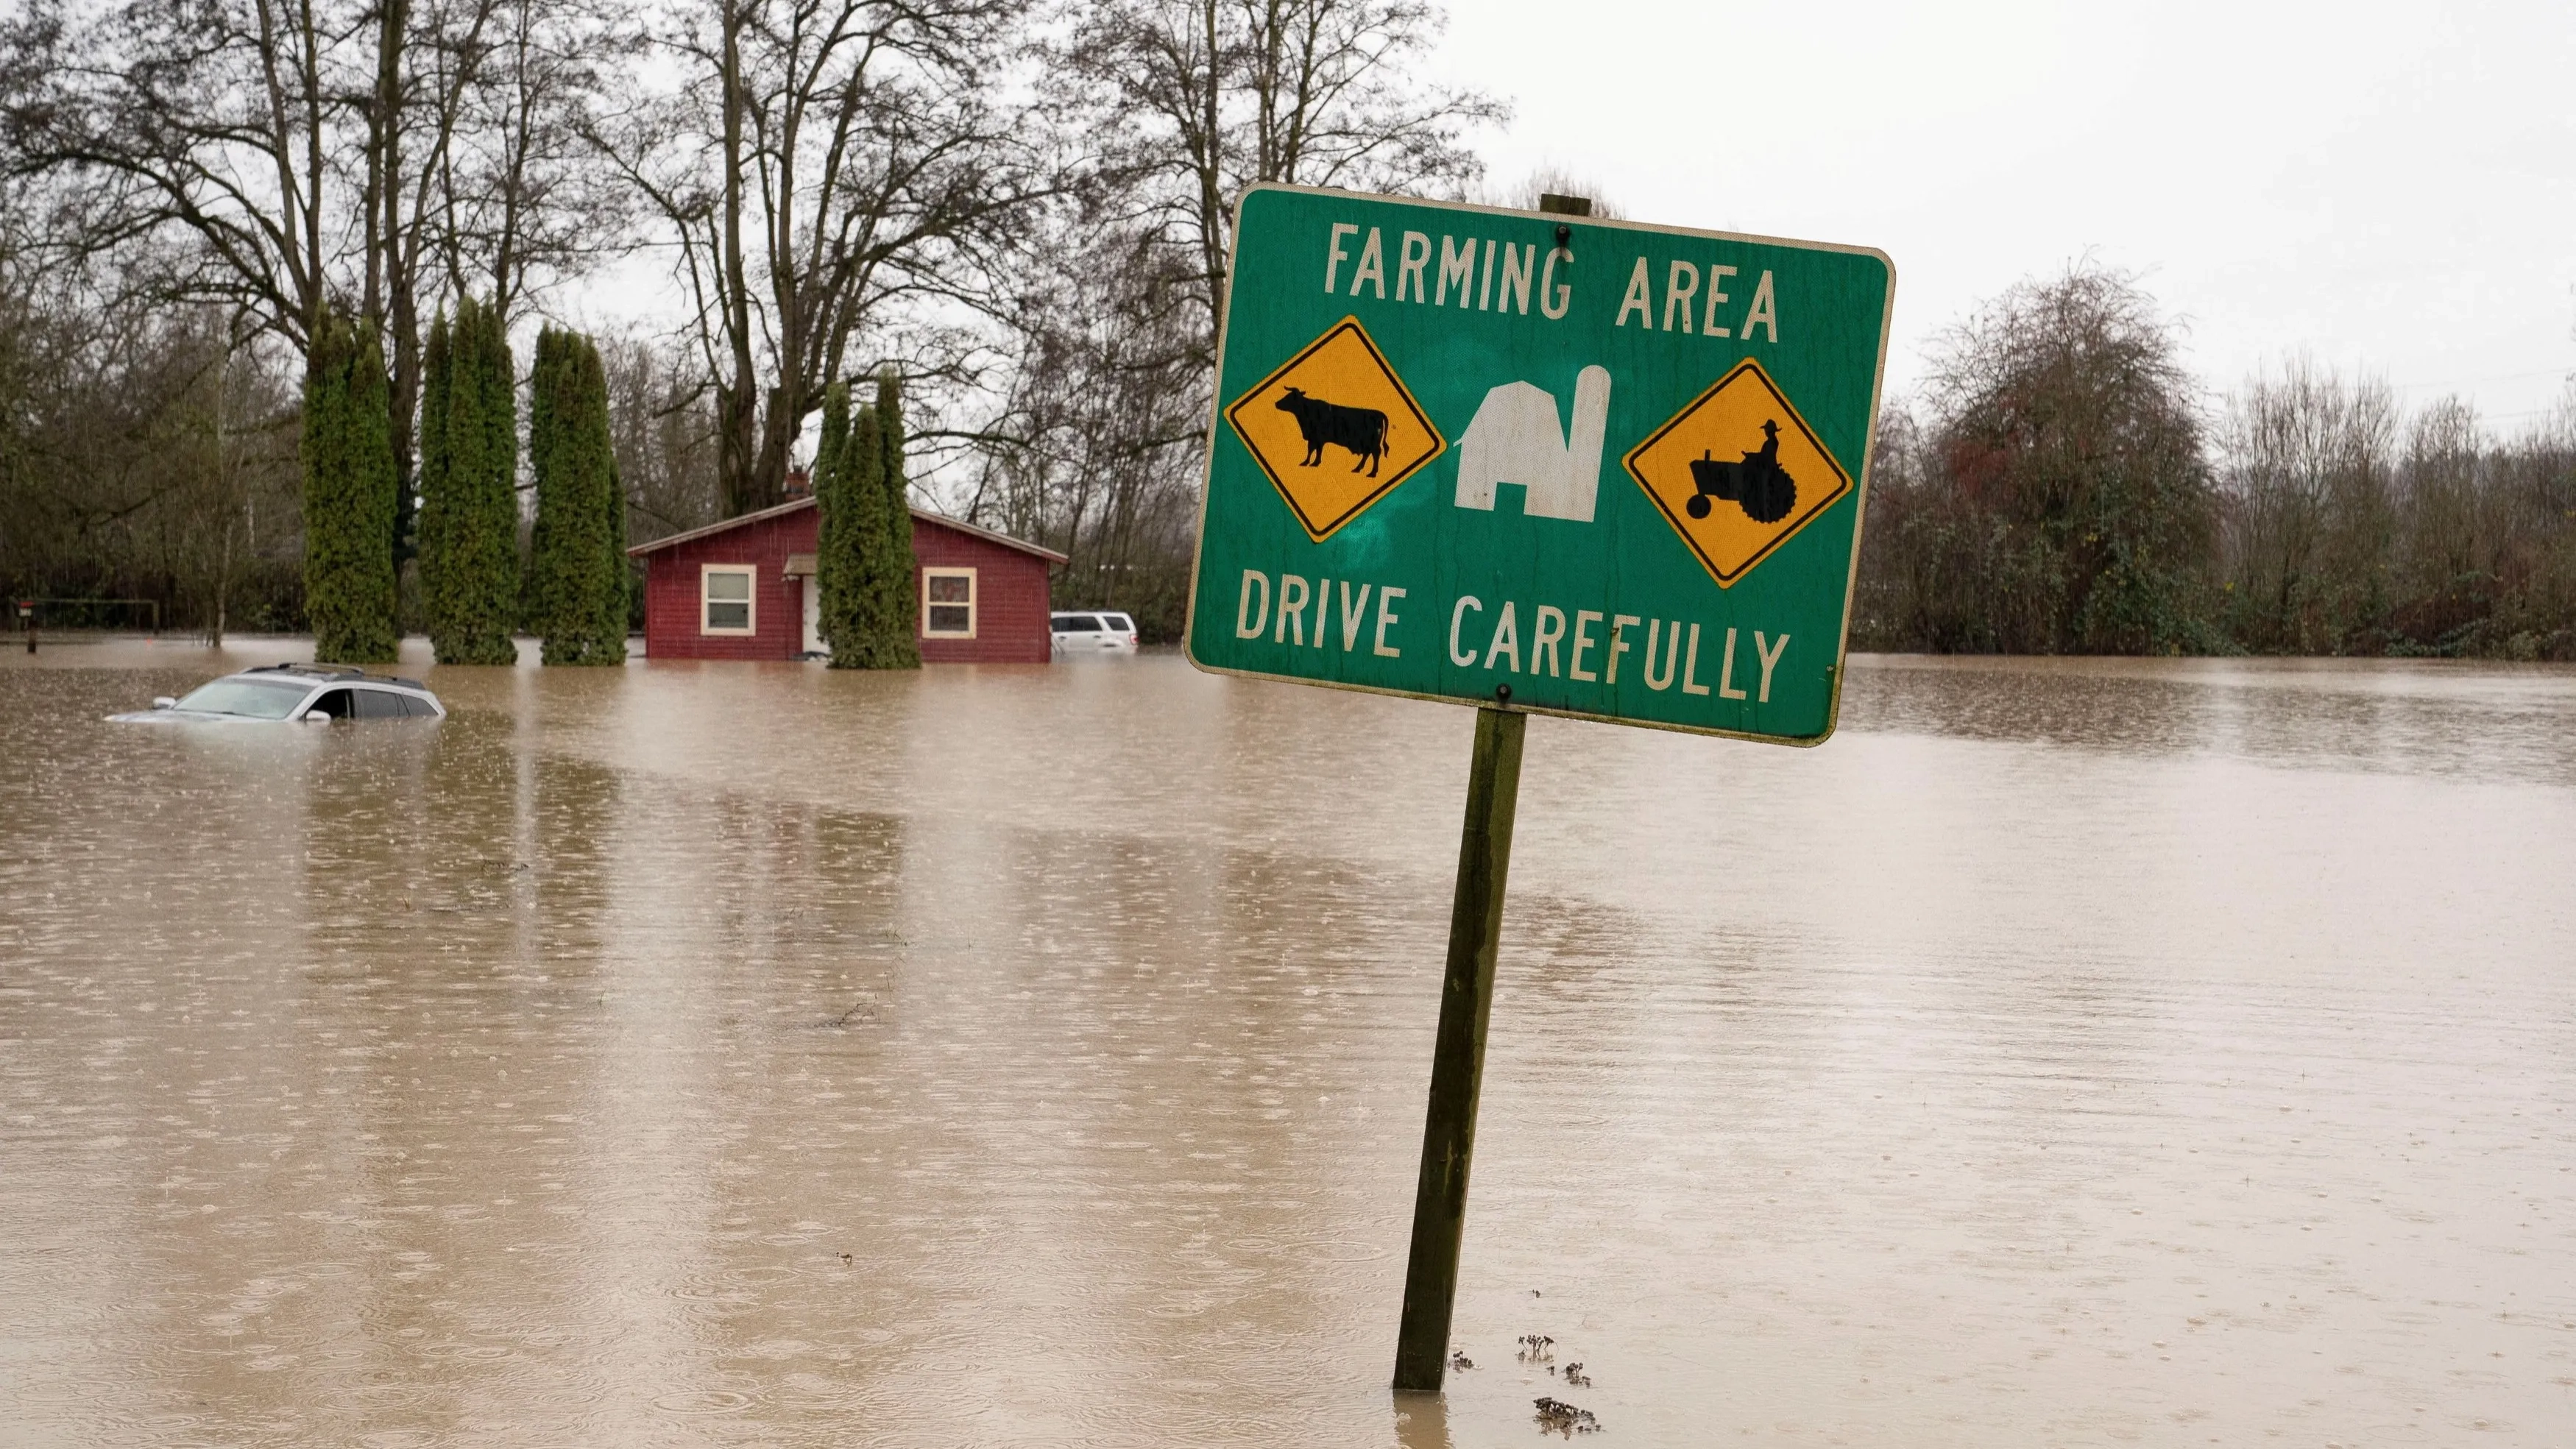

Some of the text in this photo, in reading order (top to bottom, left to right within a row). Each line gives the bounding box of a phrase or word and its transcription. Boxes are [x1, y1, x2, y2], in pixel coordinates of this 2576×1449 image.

[1325, 222, 1777, 343] FARMING AREA
[1236, 569, 1790, 703] DRIVE CAREFULLY
